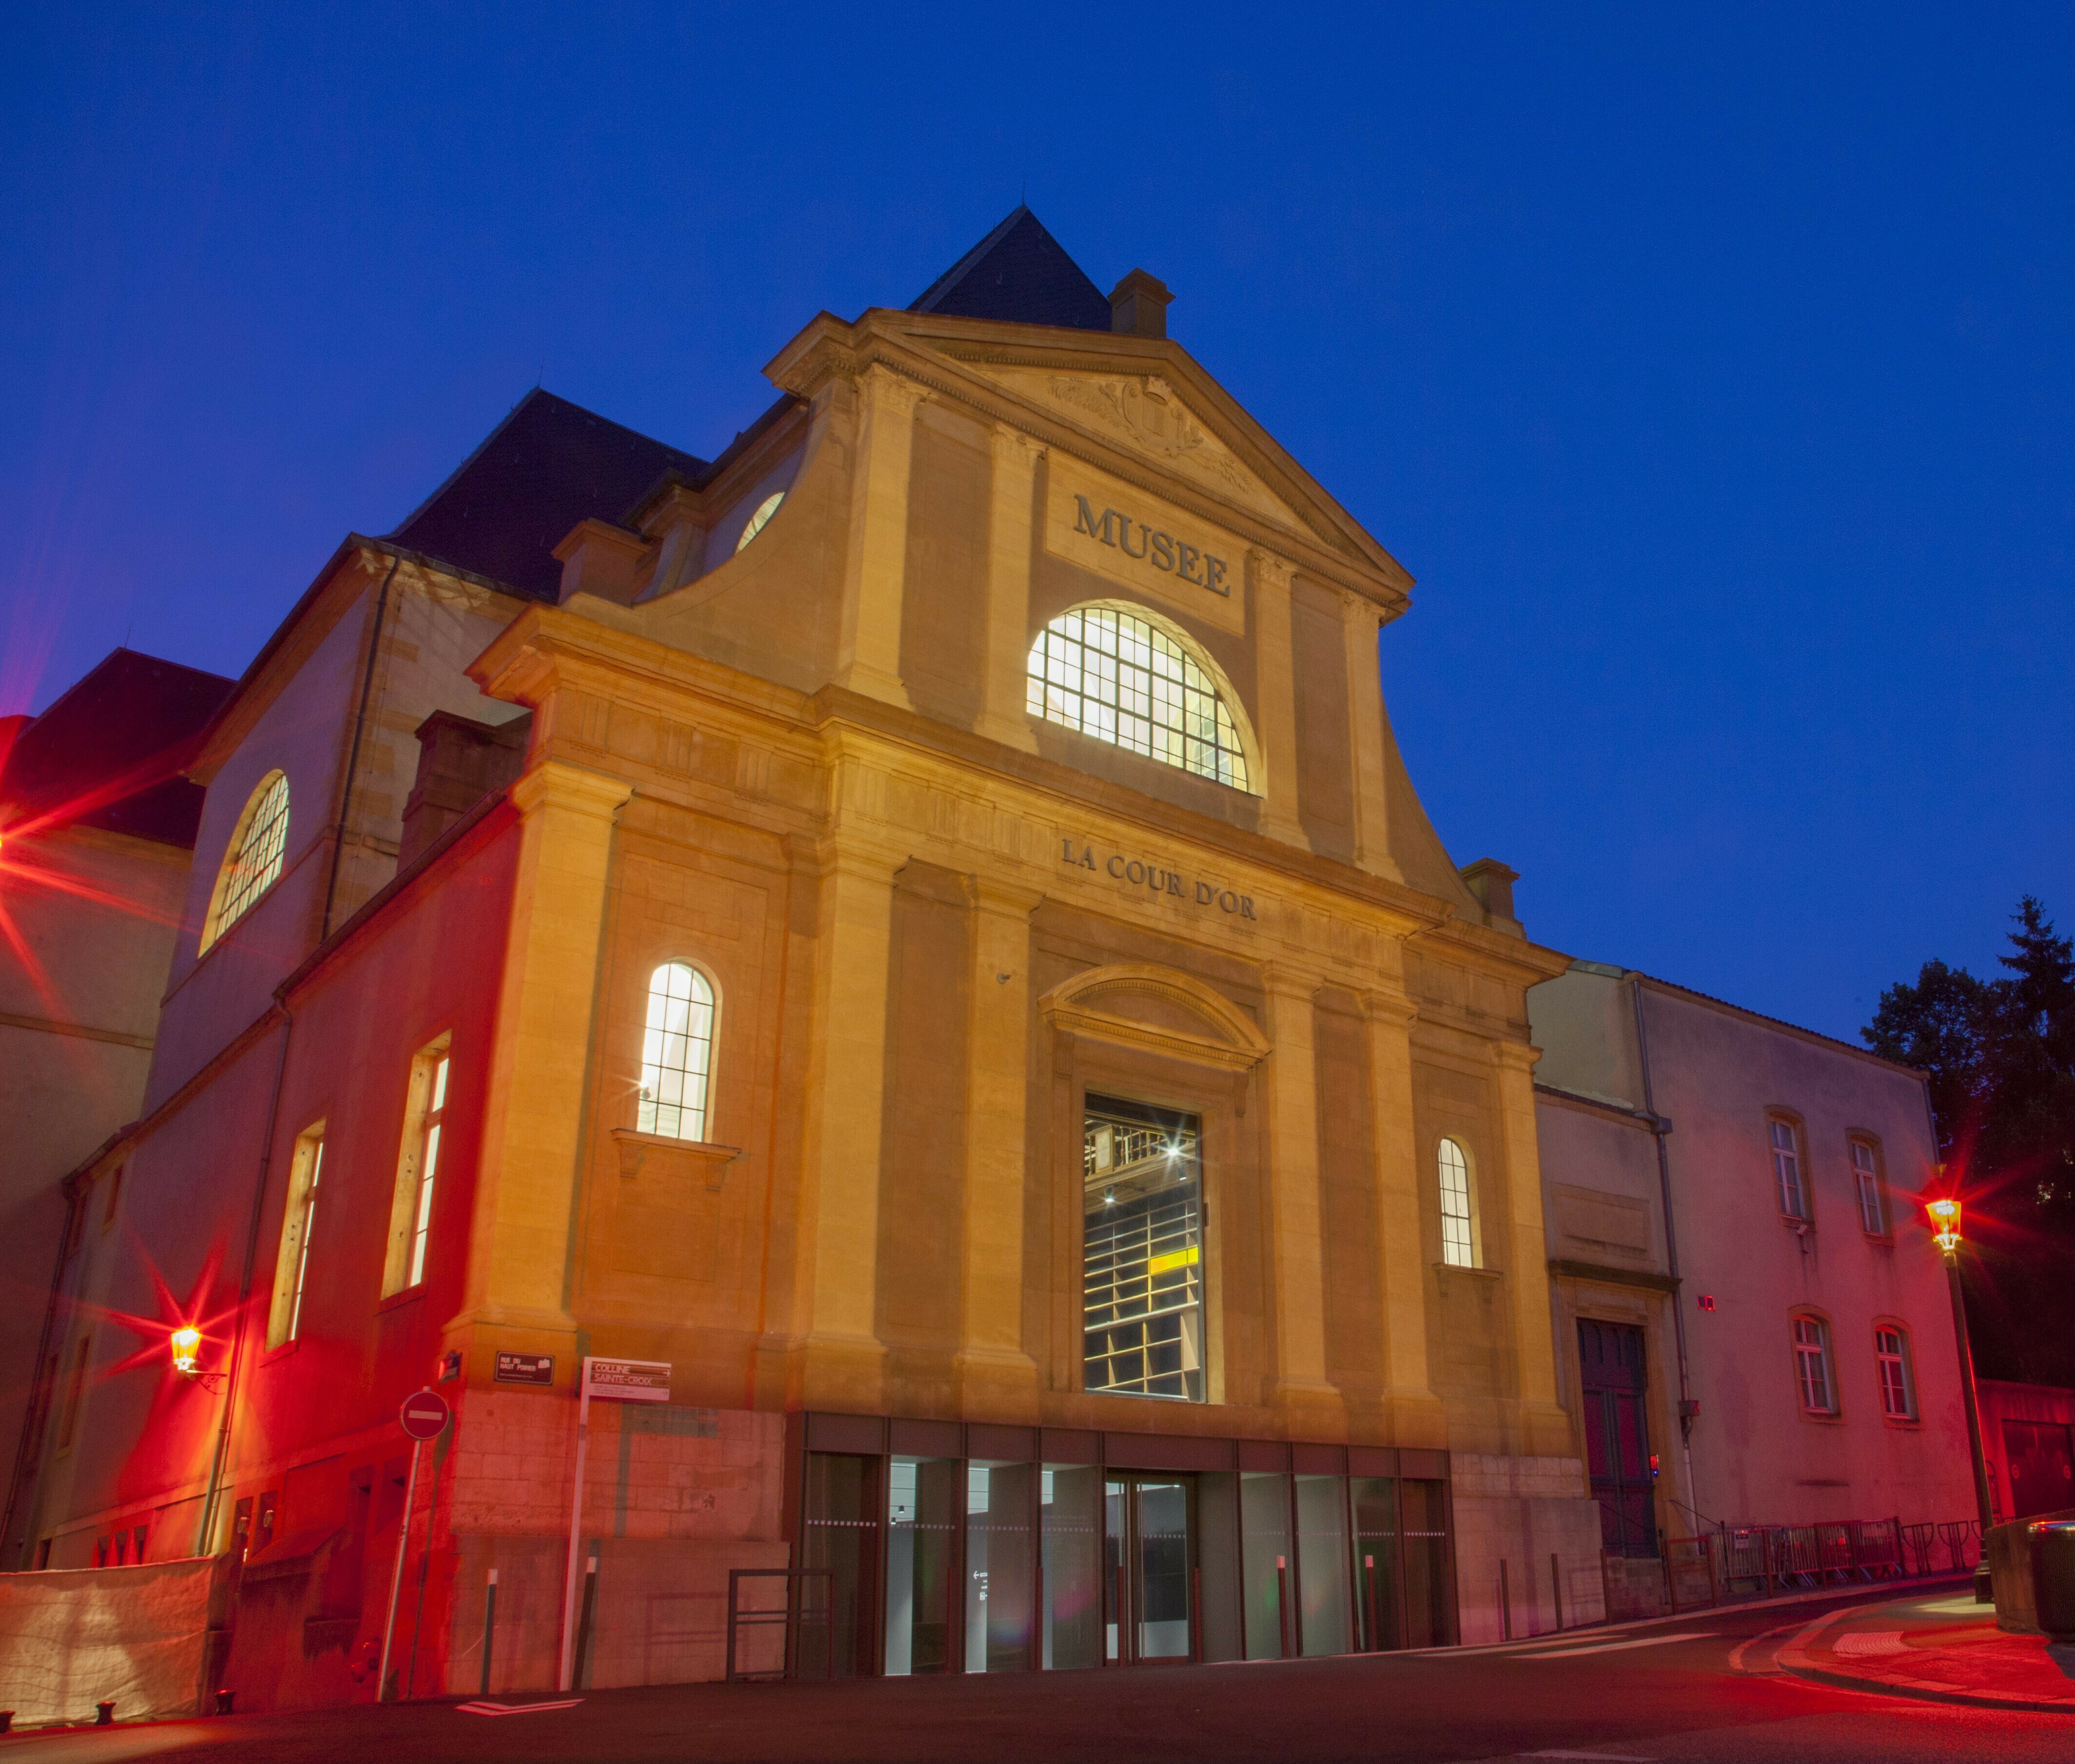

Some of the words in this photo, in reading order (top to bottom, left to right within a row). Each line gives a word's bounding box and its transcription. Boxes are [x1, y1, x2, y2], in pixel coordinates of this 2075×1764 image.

[1074, 493, 1230, 598] MUSEE
[1062, 838, 1096, 871] LA
[1107, 855, 1185, 898] COUR
[1196, 881, 1256, 921] D'OR
[594, 1374, 652, 1385] SAINTE-CROIX
[595, 1364, 630, 1374] COLLINE
